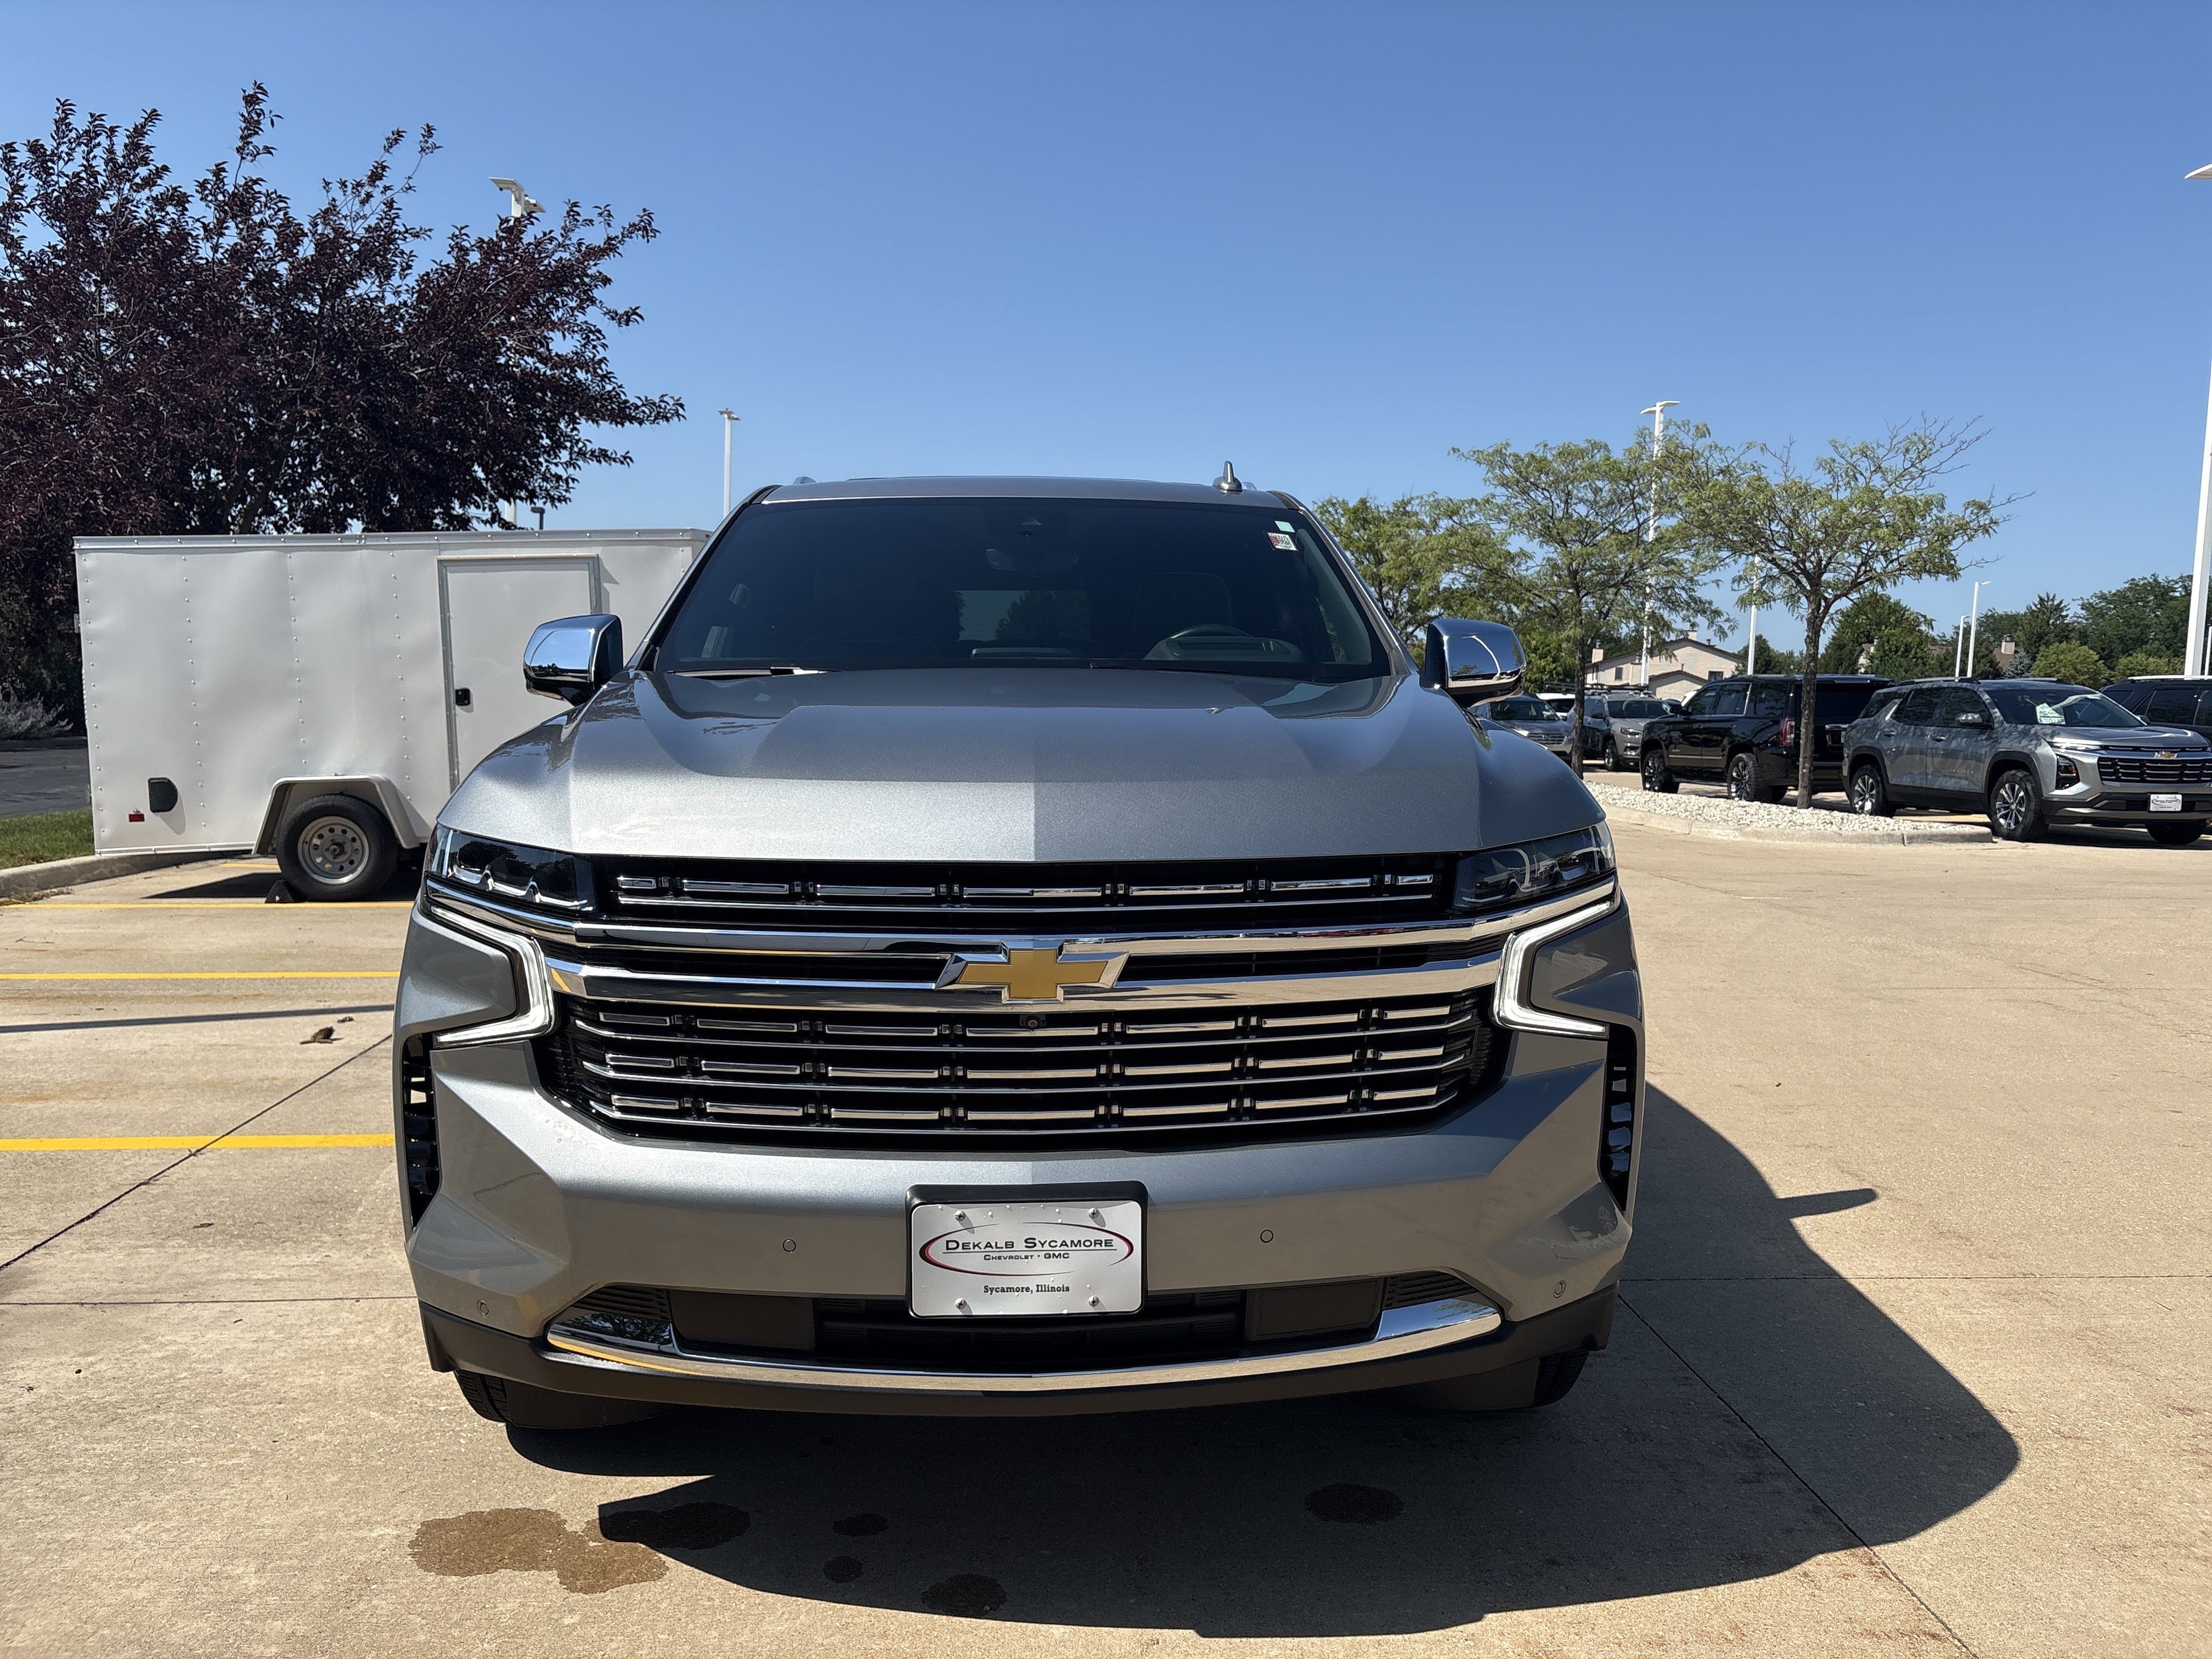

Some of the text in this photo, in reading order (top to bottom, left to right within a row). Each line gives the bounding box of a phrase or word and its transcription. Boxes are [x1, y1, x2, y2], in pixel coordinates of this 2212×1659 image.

[946, 1237, 1114, 1250] DEKALB SYCAMORE
[984, 1284, 1070, 1295] Sycamore, Illinois
